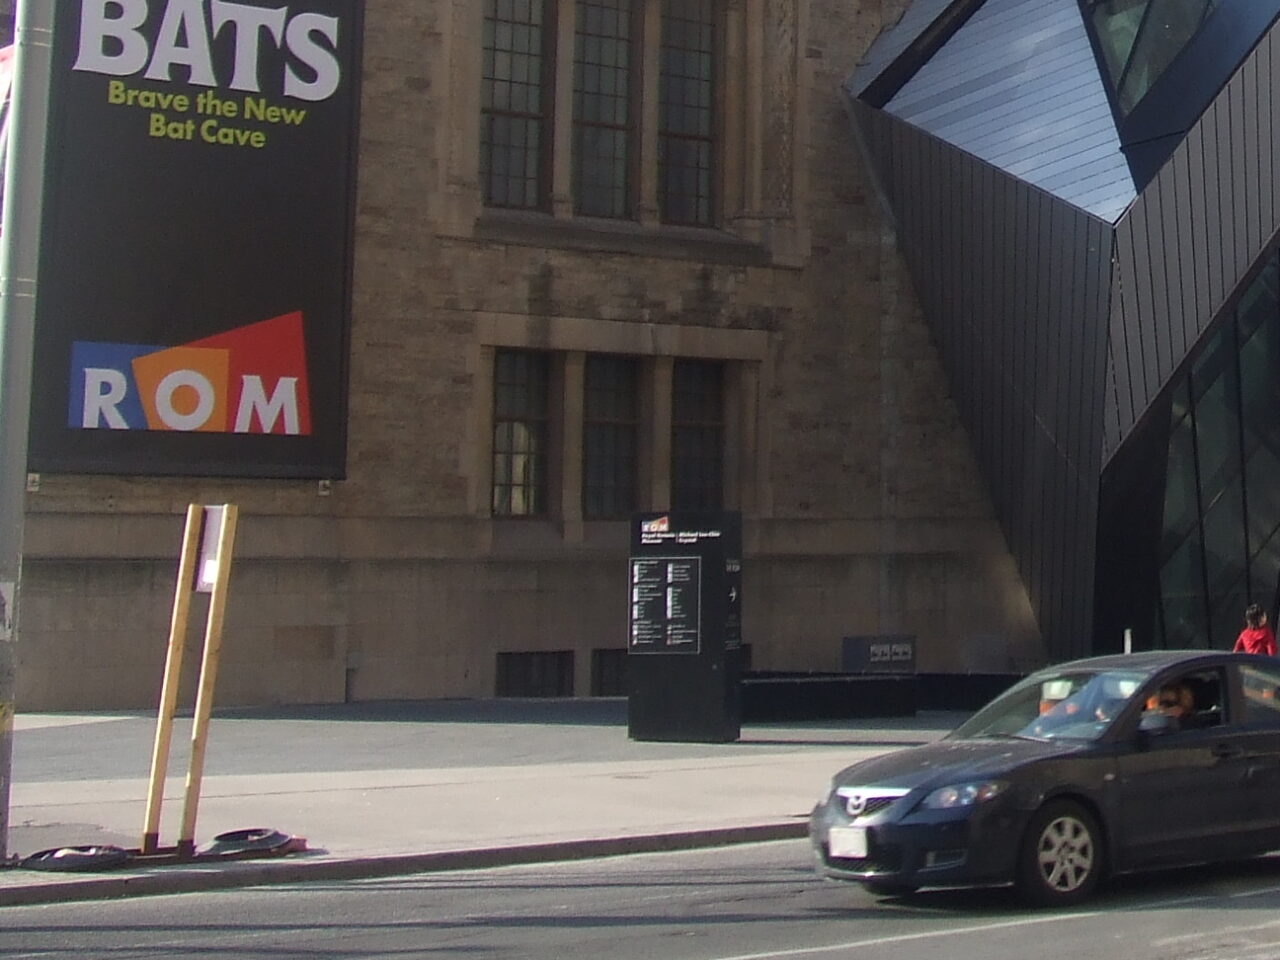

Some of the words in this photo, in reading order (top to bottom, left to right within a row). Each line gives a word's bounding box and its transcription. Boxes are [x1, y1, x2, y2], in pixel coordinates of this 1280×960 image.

[107, 80, 190, 114] Brave
[195, 90, 238, 119] the
[244, 96, 306, 127] New
[149, 113, 195, 141] Bat
[200, 122, 267, 150] Cave
[82, 367, 299, 435] ROM
